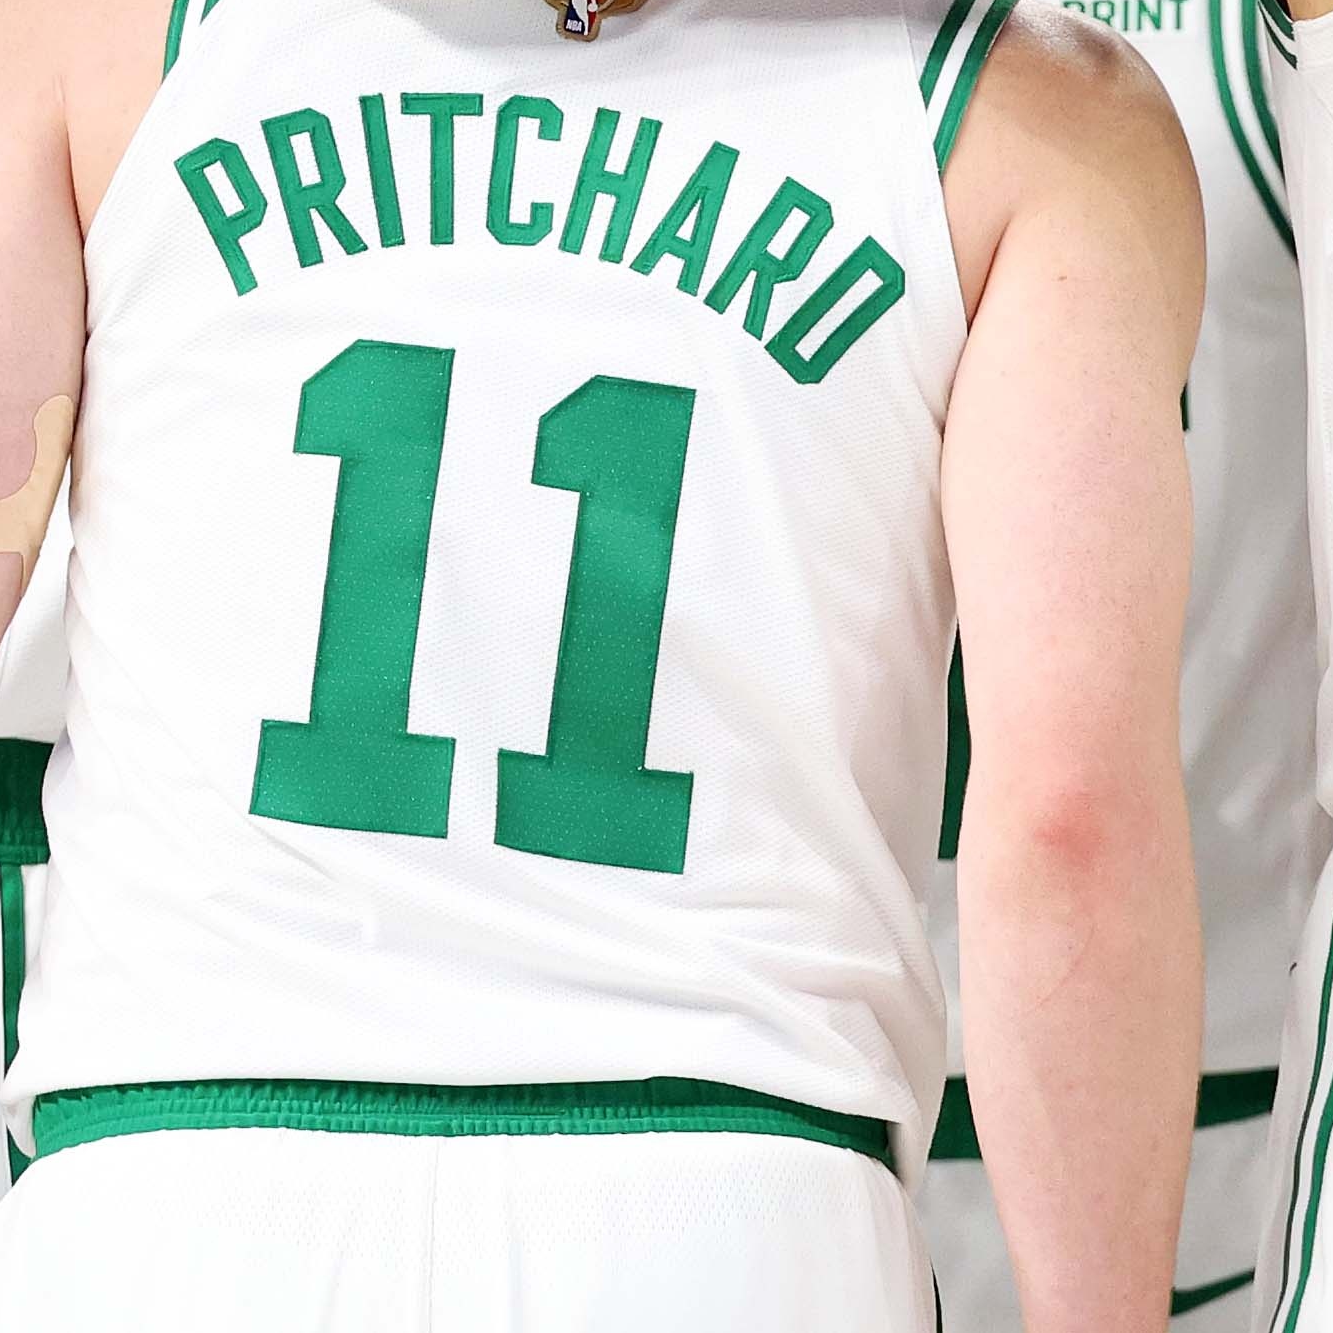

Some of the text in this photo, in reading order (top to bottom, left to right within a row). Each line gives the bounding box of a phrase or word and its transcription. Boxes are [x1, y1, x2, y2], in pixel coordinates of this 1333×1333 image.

[565, 18, 583, 32] NBA
[173, 91, 906, 385] PRITCHARD
[248, 338, 697, 875] 11
